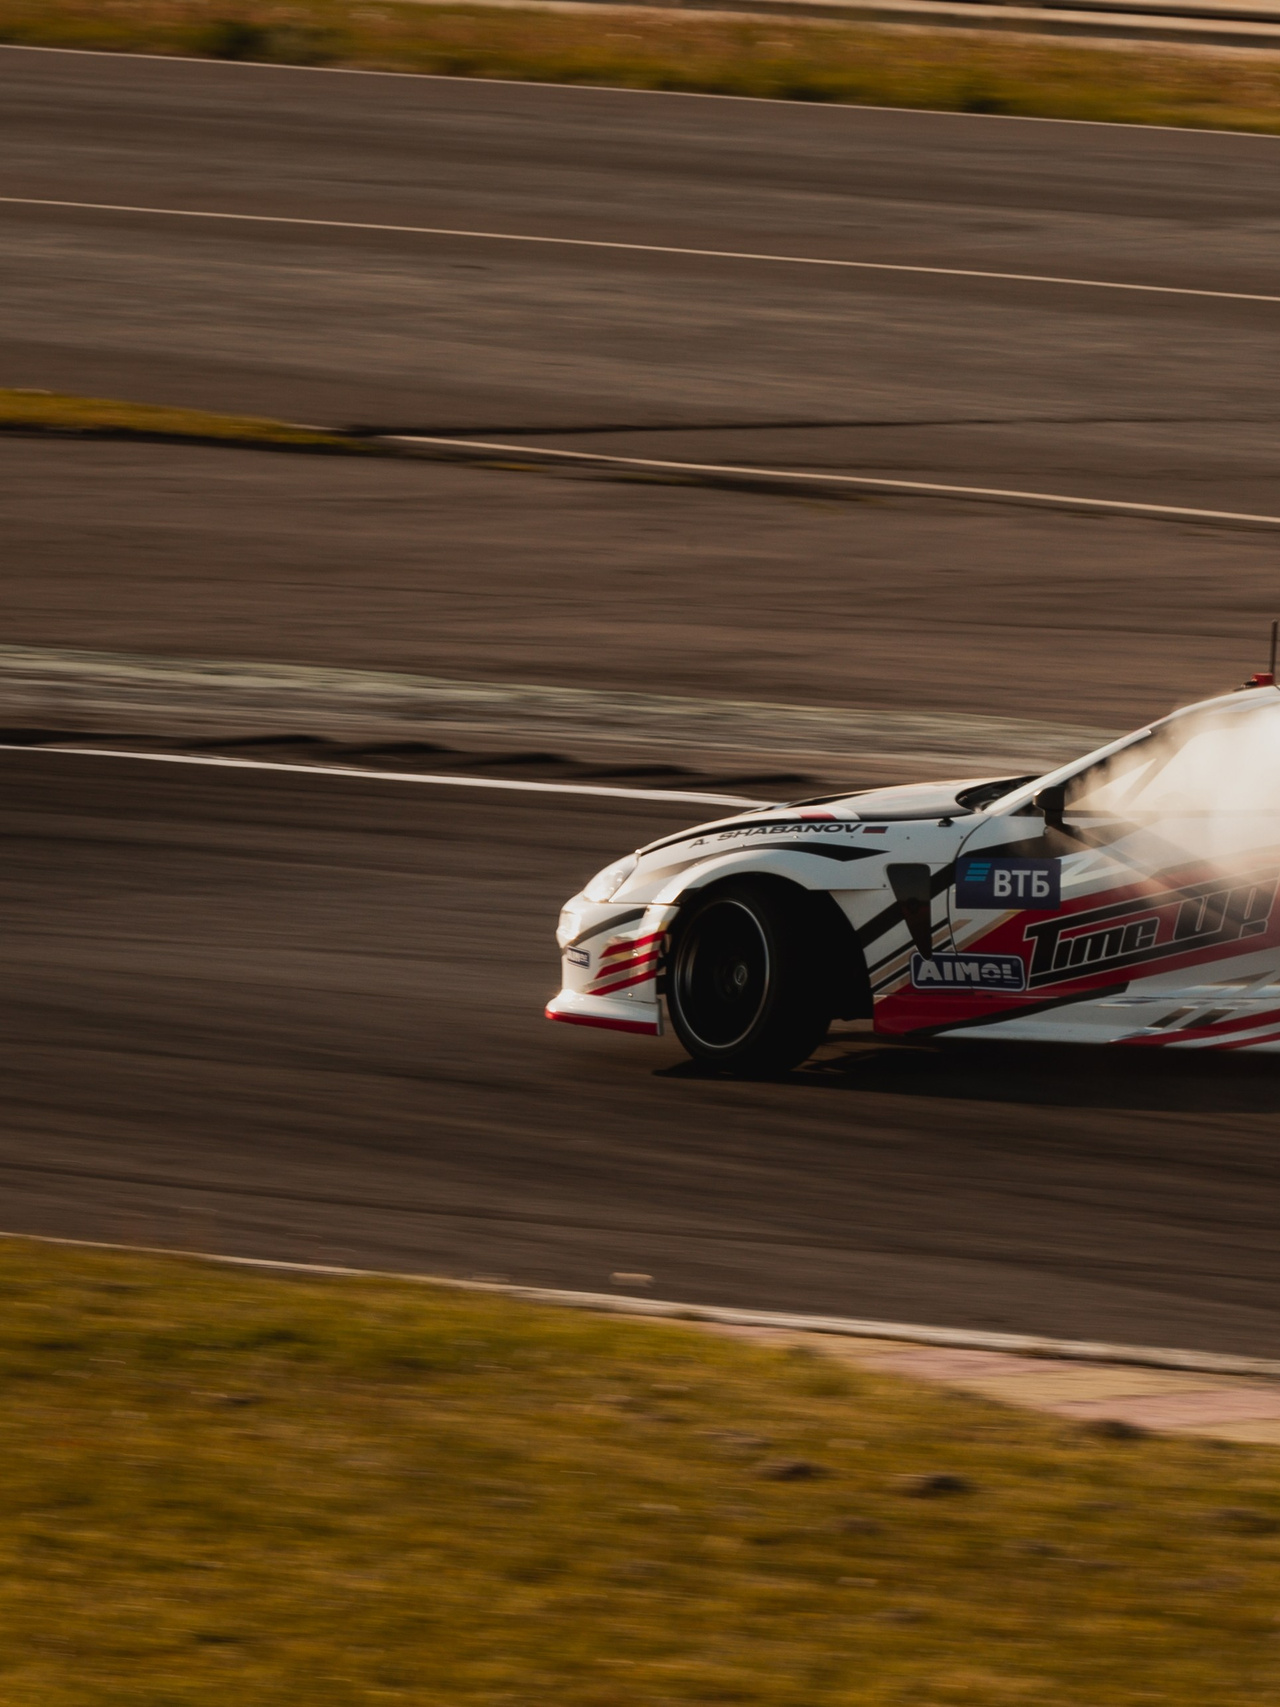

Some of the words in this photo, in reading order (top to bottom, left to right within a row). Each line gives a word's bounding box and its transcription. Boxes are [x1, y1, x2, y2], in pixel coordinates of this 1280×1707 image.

[688, 838, 709, 849] A.
[717, 824, 862, 841] SHABANOV
[993, 869, 1050, 897] ВТБ
[917, 961, 1020, 982] AIMOL
